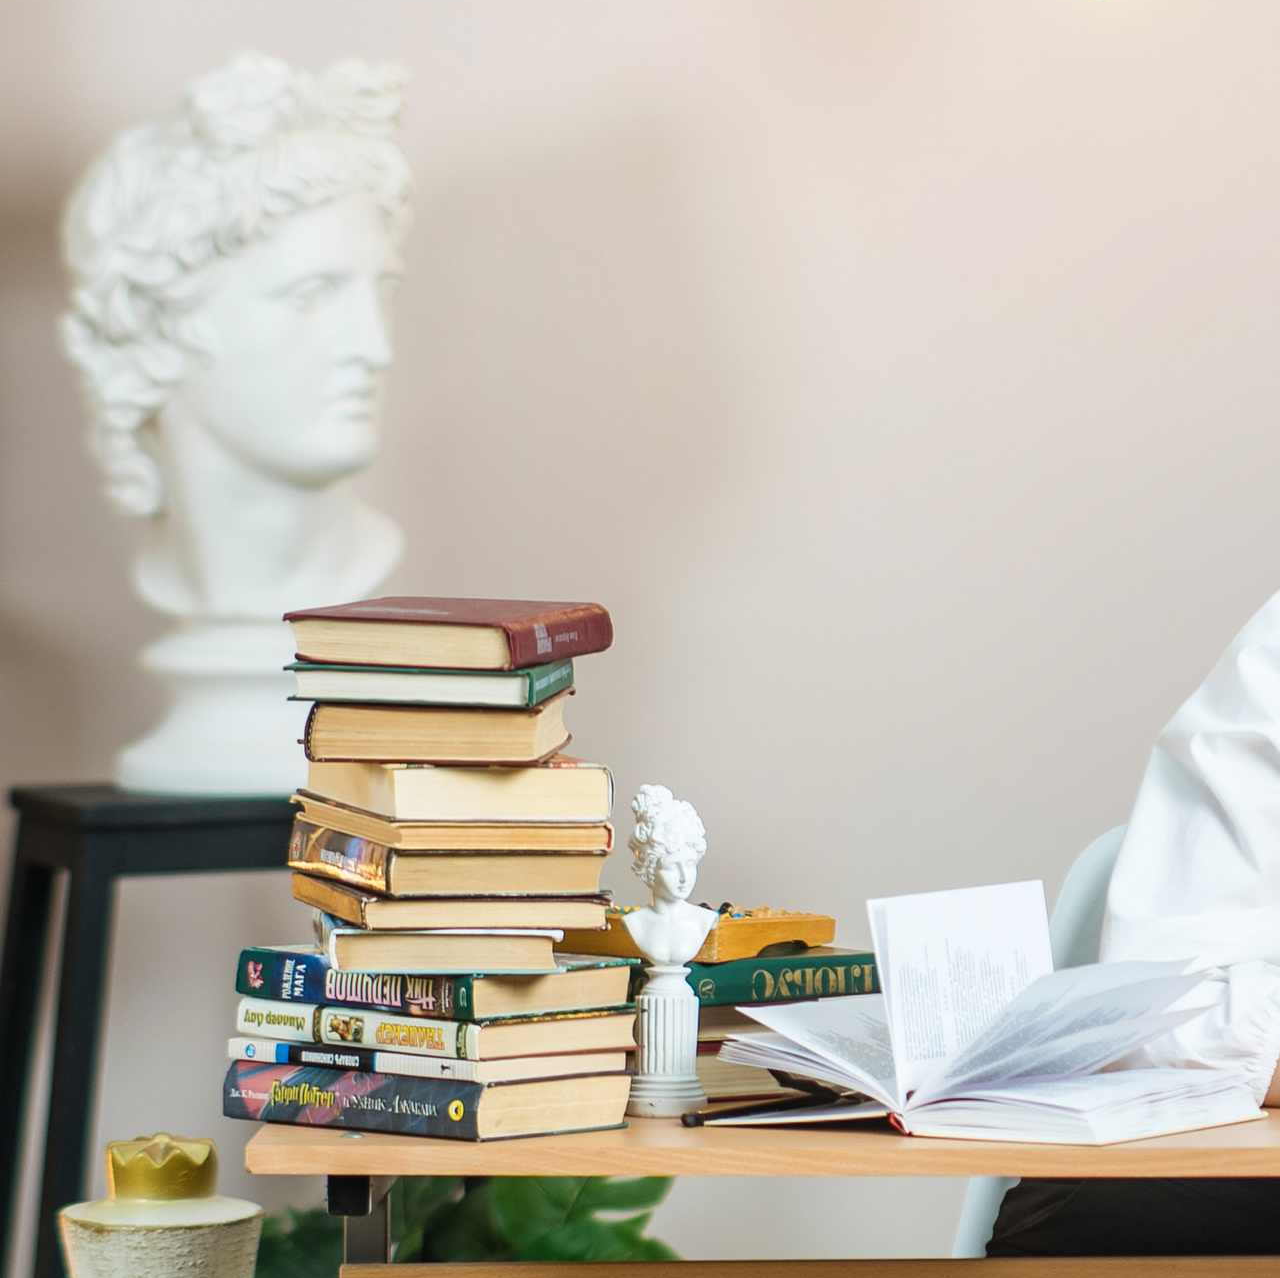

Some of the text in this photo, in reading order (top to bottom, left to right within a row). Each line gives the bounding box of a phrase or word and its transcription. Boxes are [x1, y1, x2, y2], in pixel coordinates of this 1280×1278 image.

[293, 964, 307, 997] МАГА
[325, 969, 402, 1007] ПЕРУМОВ
[752, 964, 876, 1000] ГЛОБУС
[265, 1011, 306, 1030] Миллер
[376, 1022, 446, 1050] ТАЛИСКЕР
